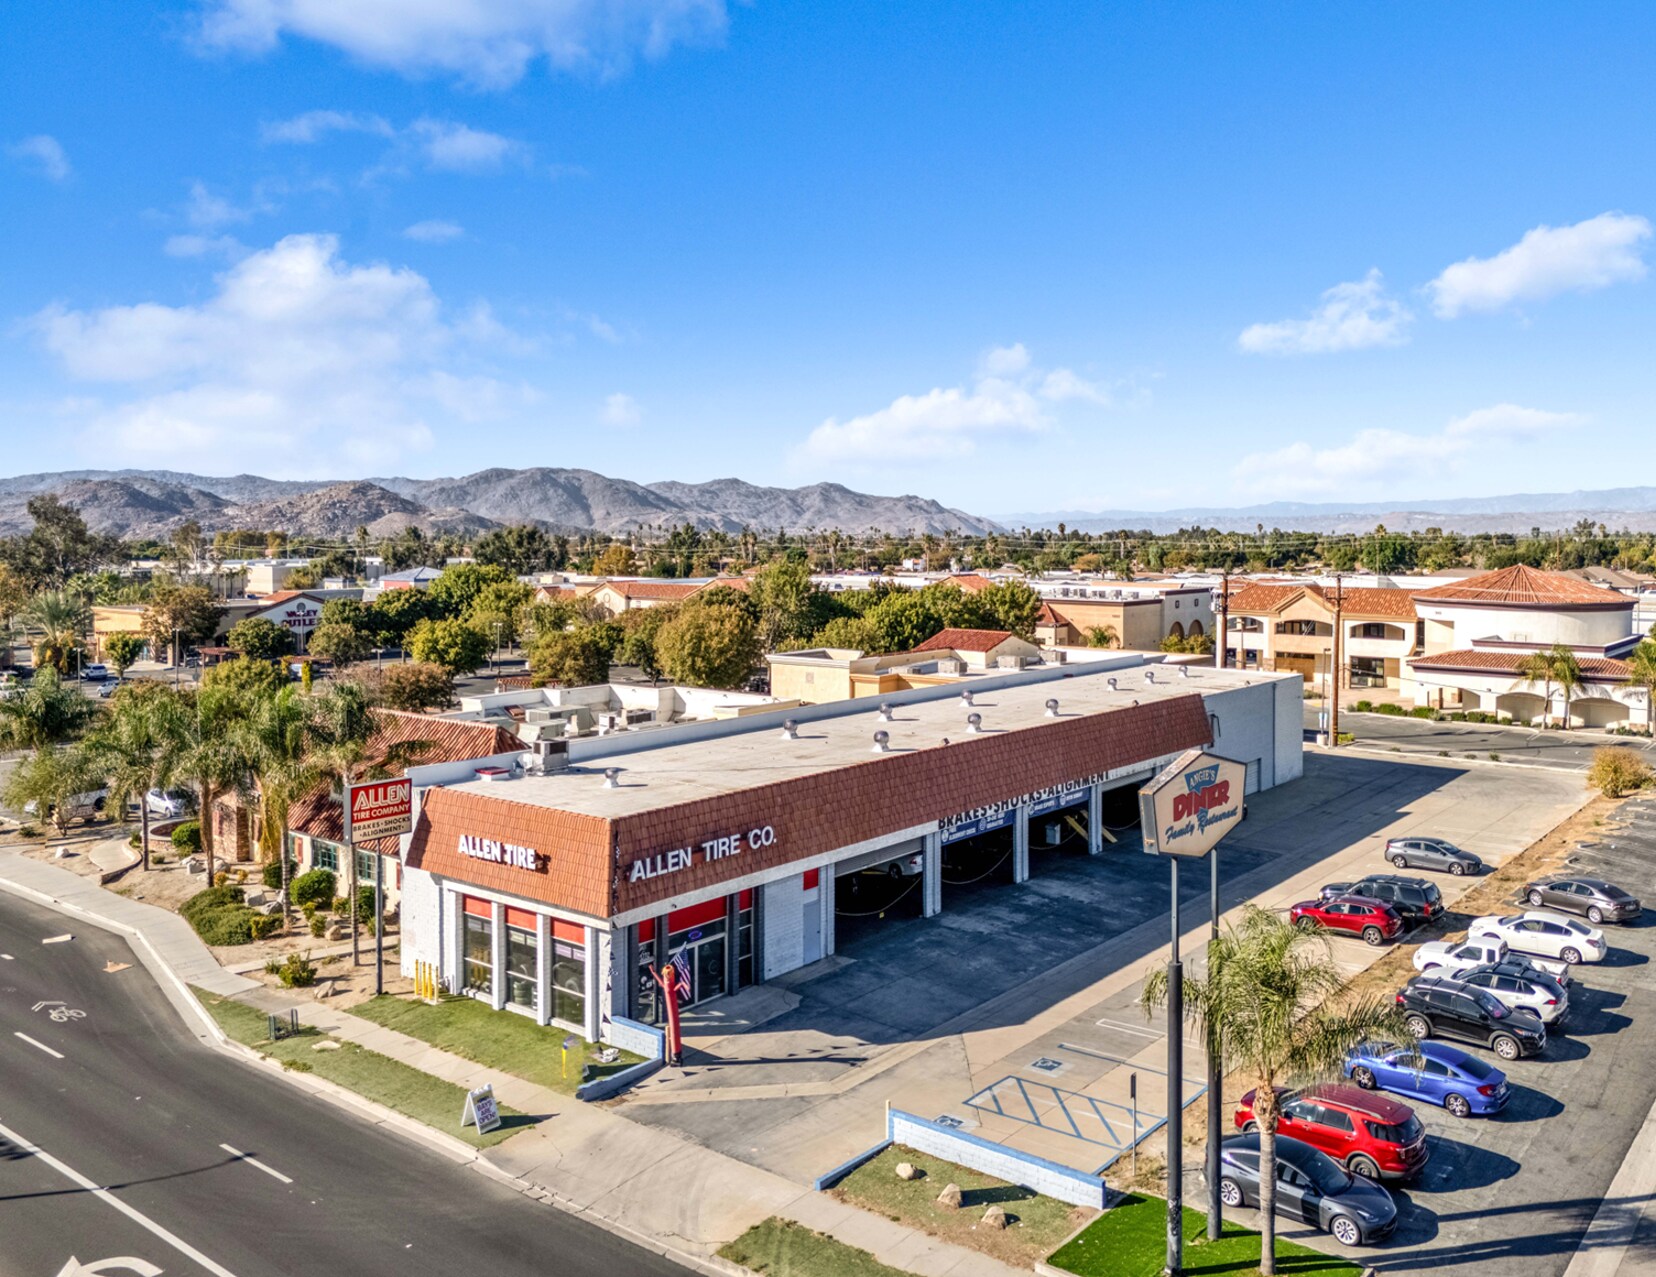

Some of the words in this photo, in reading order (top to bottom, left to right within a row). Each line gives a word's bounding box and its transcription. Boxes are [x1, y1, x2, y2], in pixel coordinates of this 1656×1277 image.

[282, 618, 317, 627] OUTLE
[1189, 769, 1216, 788] ANGIE'S
[353, 783, 410, 811] ALLEN
[938, 806, 988, 830] BRAKES
[993, 789, 1043, 813] SHOCKS
[1048, 772, 1109, 798] ALIGNMENT
[1173, 779, 1230, 822] DINER
[353, 810, 371, 821] TIRE
[371, 803, 410, 818] COMPANY
[353, 821, 380, 832] BRAKES
[384, 816, 411, 827] SHOCKS
[1164, 820, 1195, 845] Family
[1197, 806, 1238, 832] Restaurant
[362, 825, 401, 838] ALIGNMENT
[458, 834, 502, 862] ALLEN
[503, 843, 537, 870] TIRE
[630, 846, 693, 883] ALLEN
[702, 833, 741, 862] TIRE
[748, 825, 778, 850] CO.
